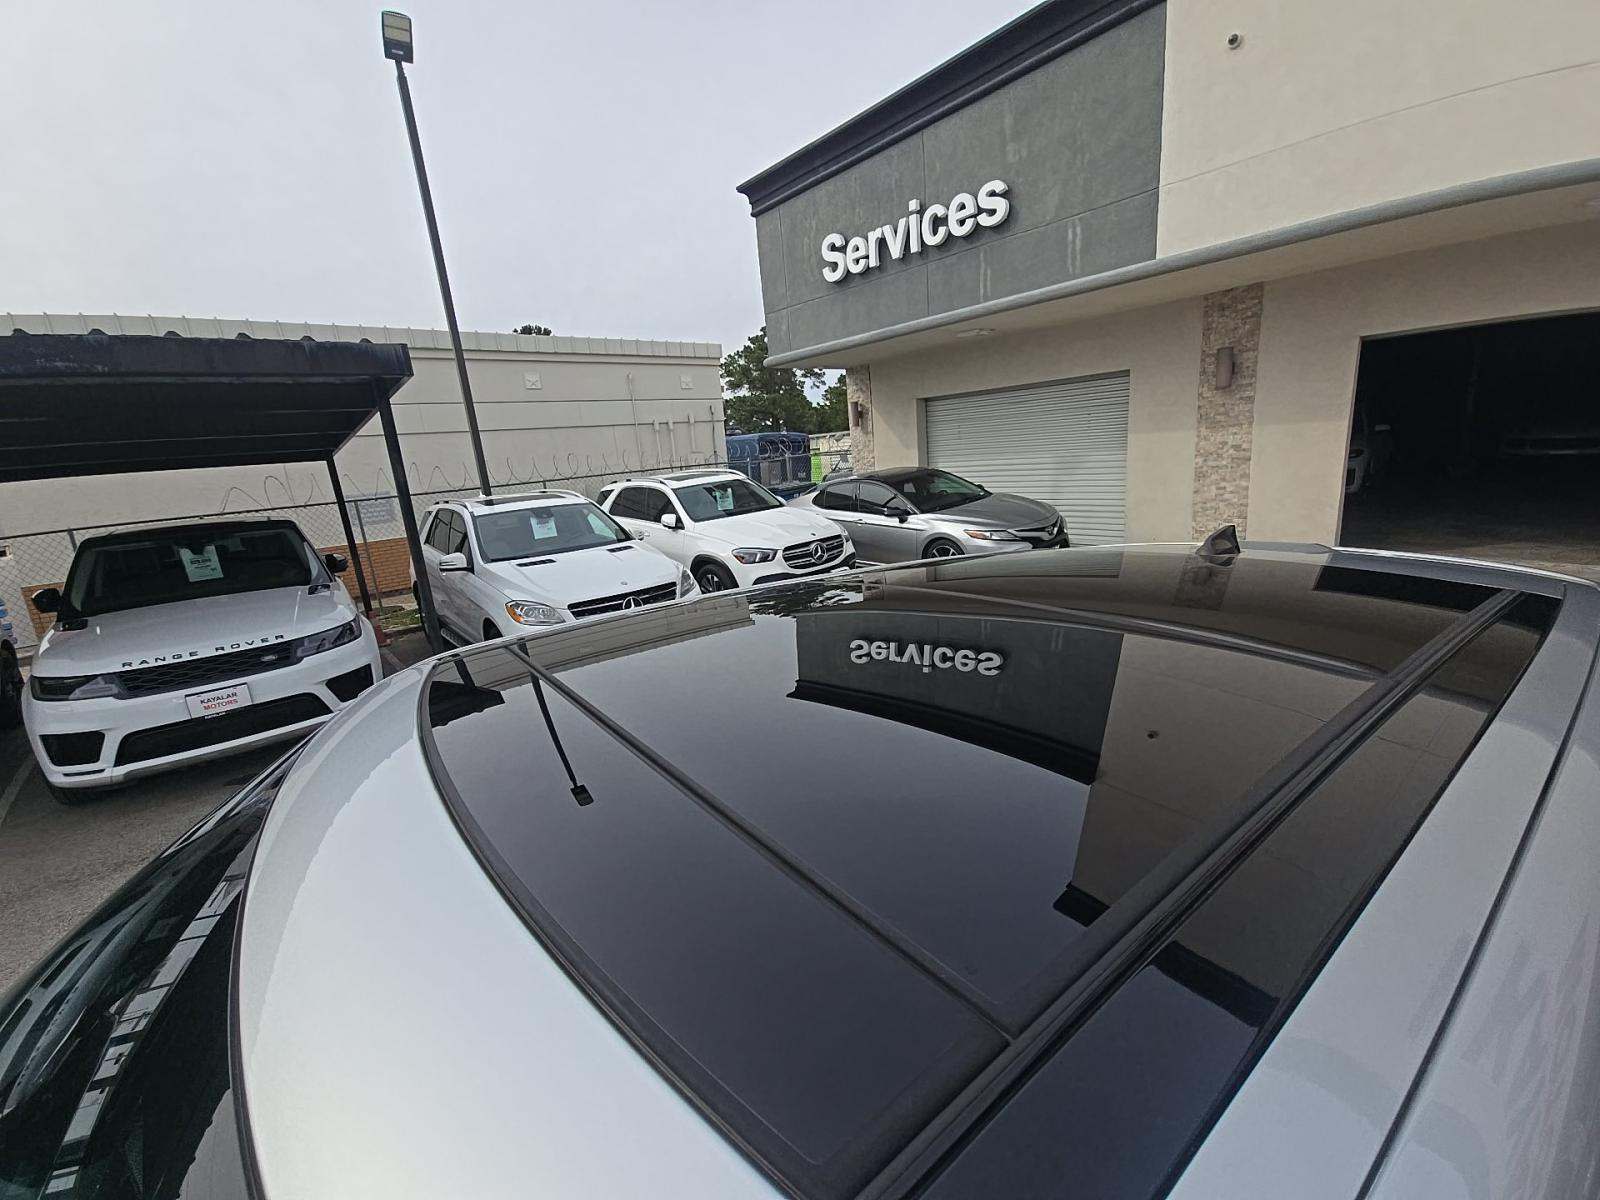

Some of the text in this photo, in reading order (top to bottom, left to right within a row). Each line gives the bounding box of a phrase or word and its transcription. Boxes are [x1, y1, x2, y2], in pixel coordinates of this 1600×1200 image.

[821, 179, 1010, 283] Services
[121, 634, 284, 668] RANGE ROVER
[200, 692, 237, 704] KAYALAR
[203, 699, 238, 710] MOTORS
